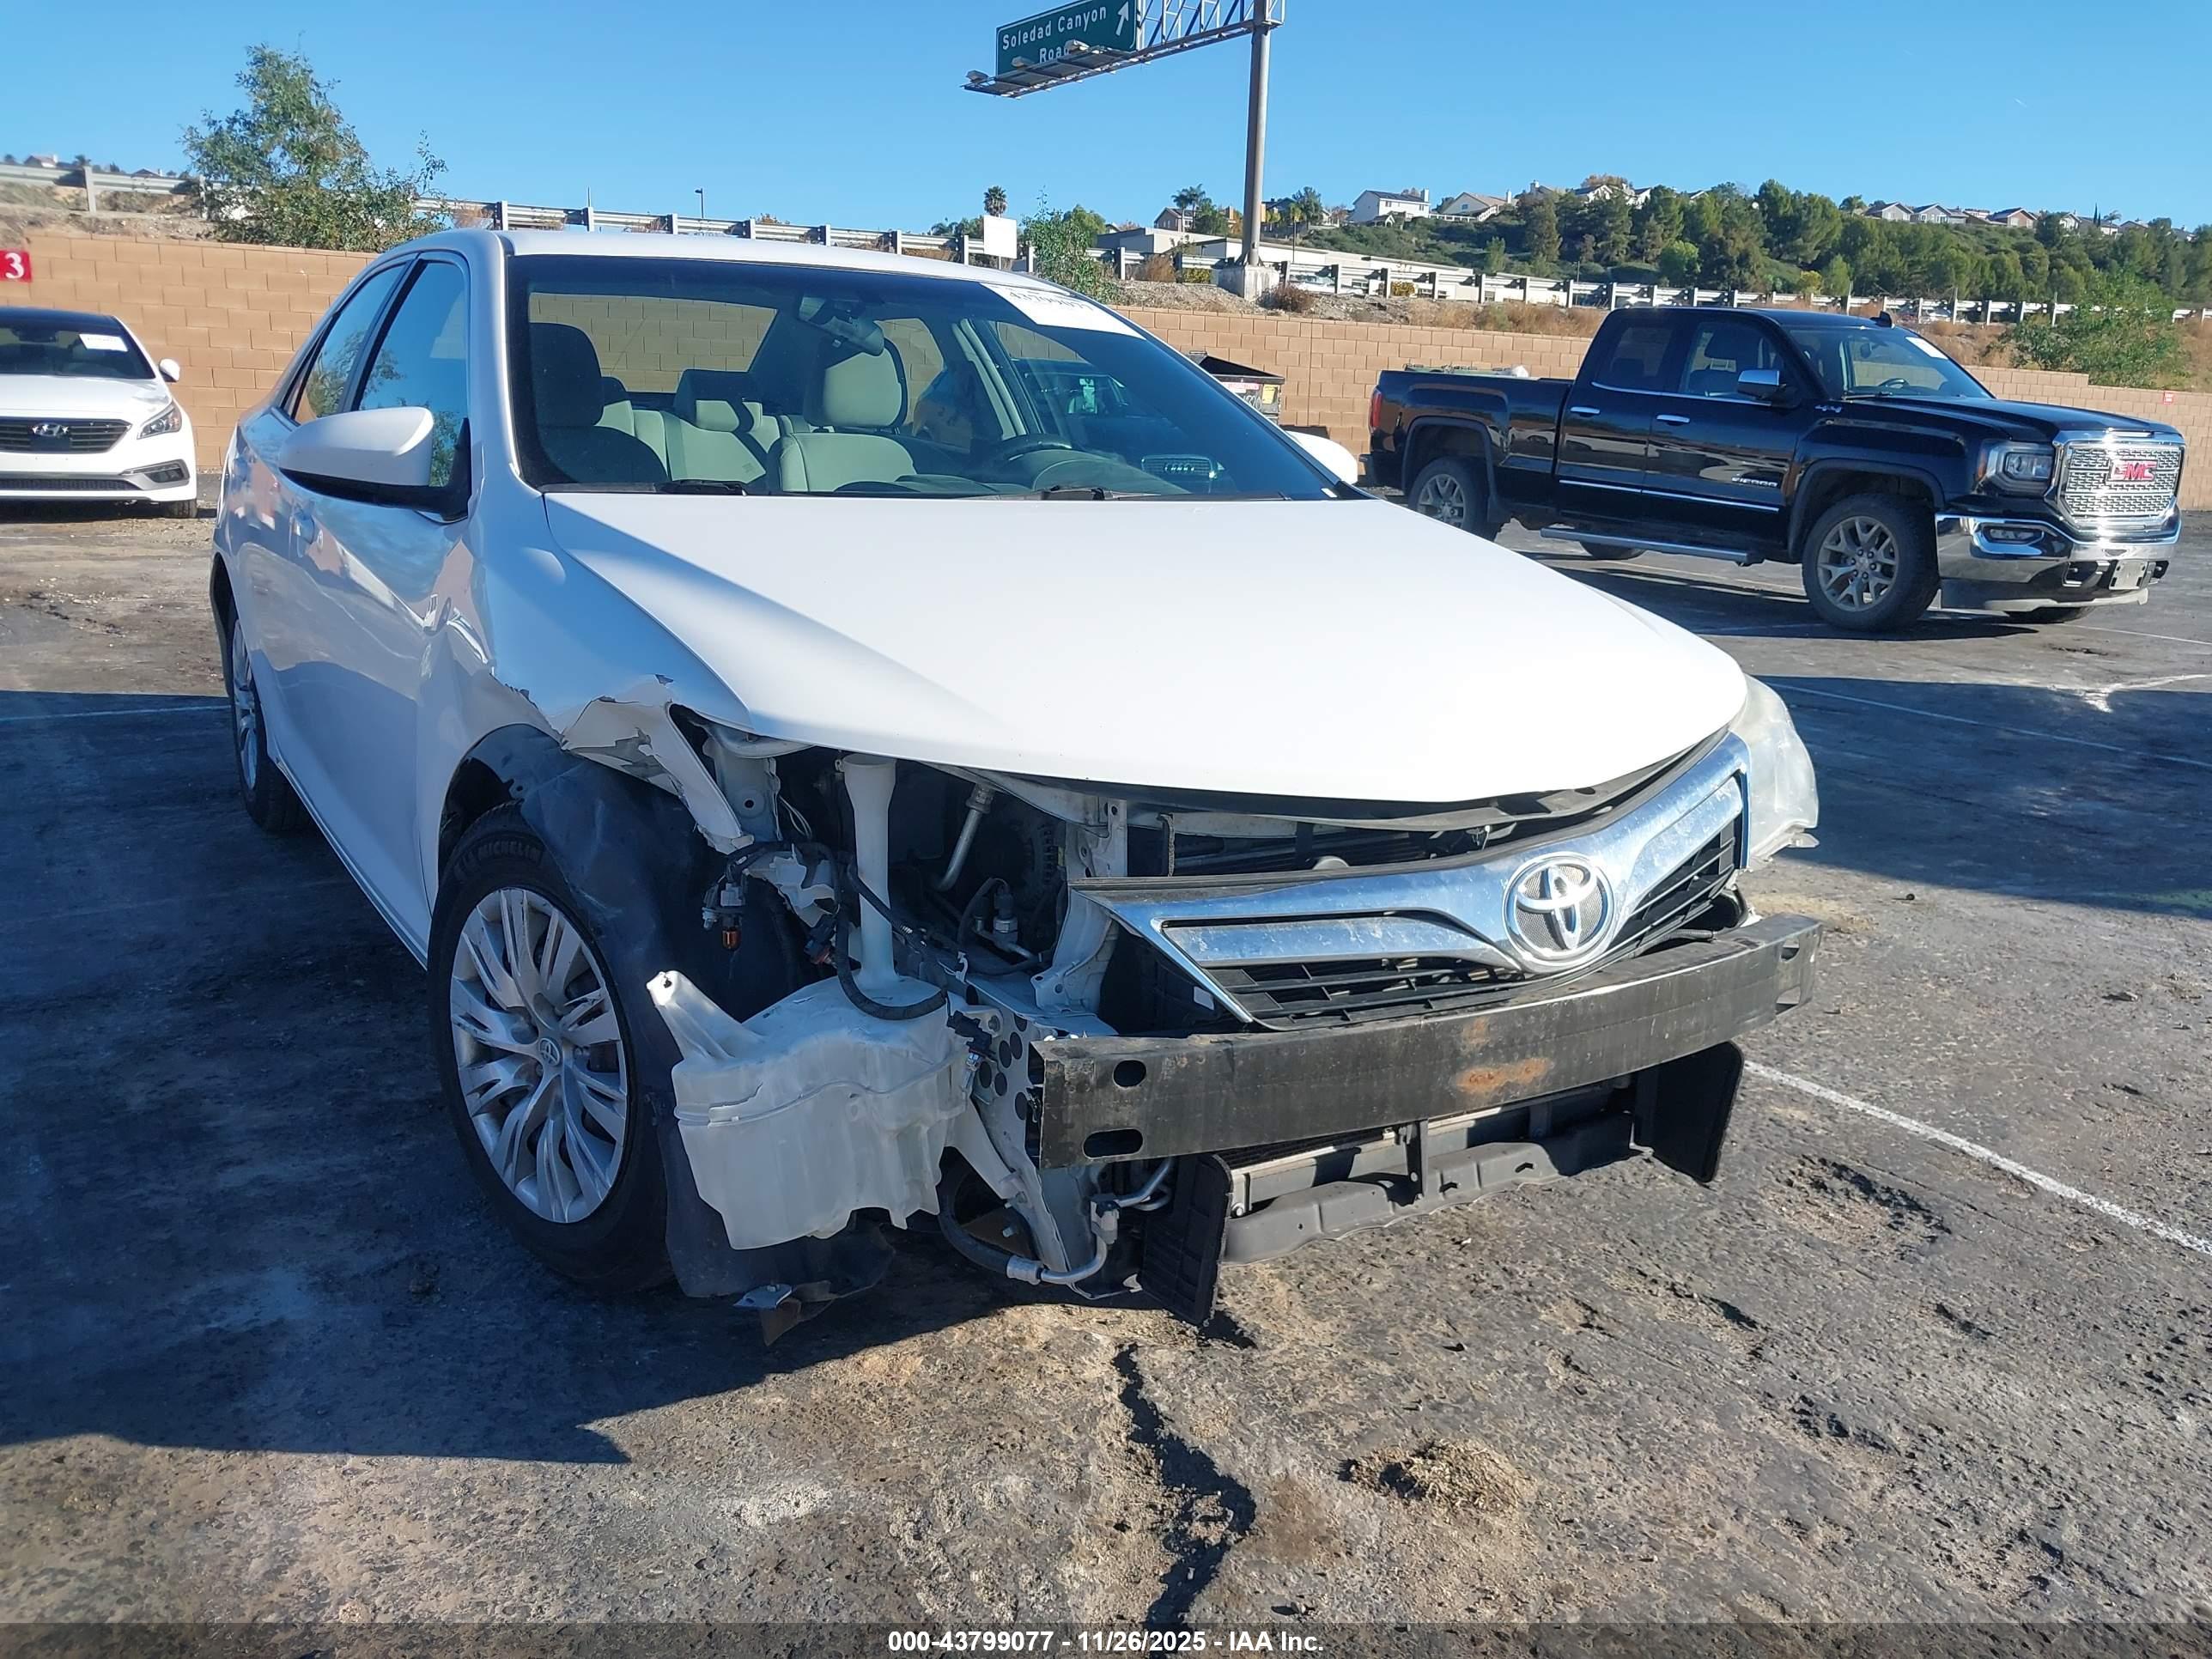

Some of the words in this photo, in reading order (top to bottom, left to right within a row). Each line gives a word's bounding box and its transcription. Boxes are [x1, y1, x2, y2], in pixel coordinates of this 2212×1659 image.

[1002, 21, 1052, 51] Soledad
[1057, 6, 1107, 32] Canyon
[5, 252, 24, 278] 3
[2111, 460, 2158, 481] GMC
